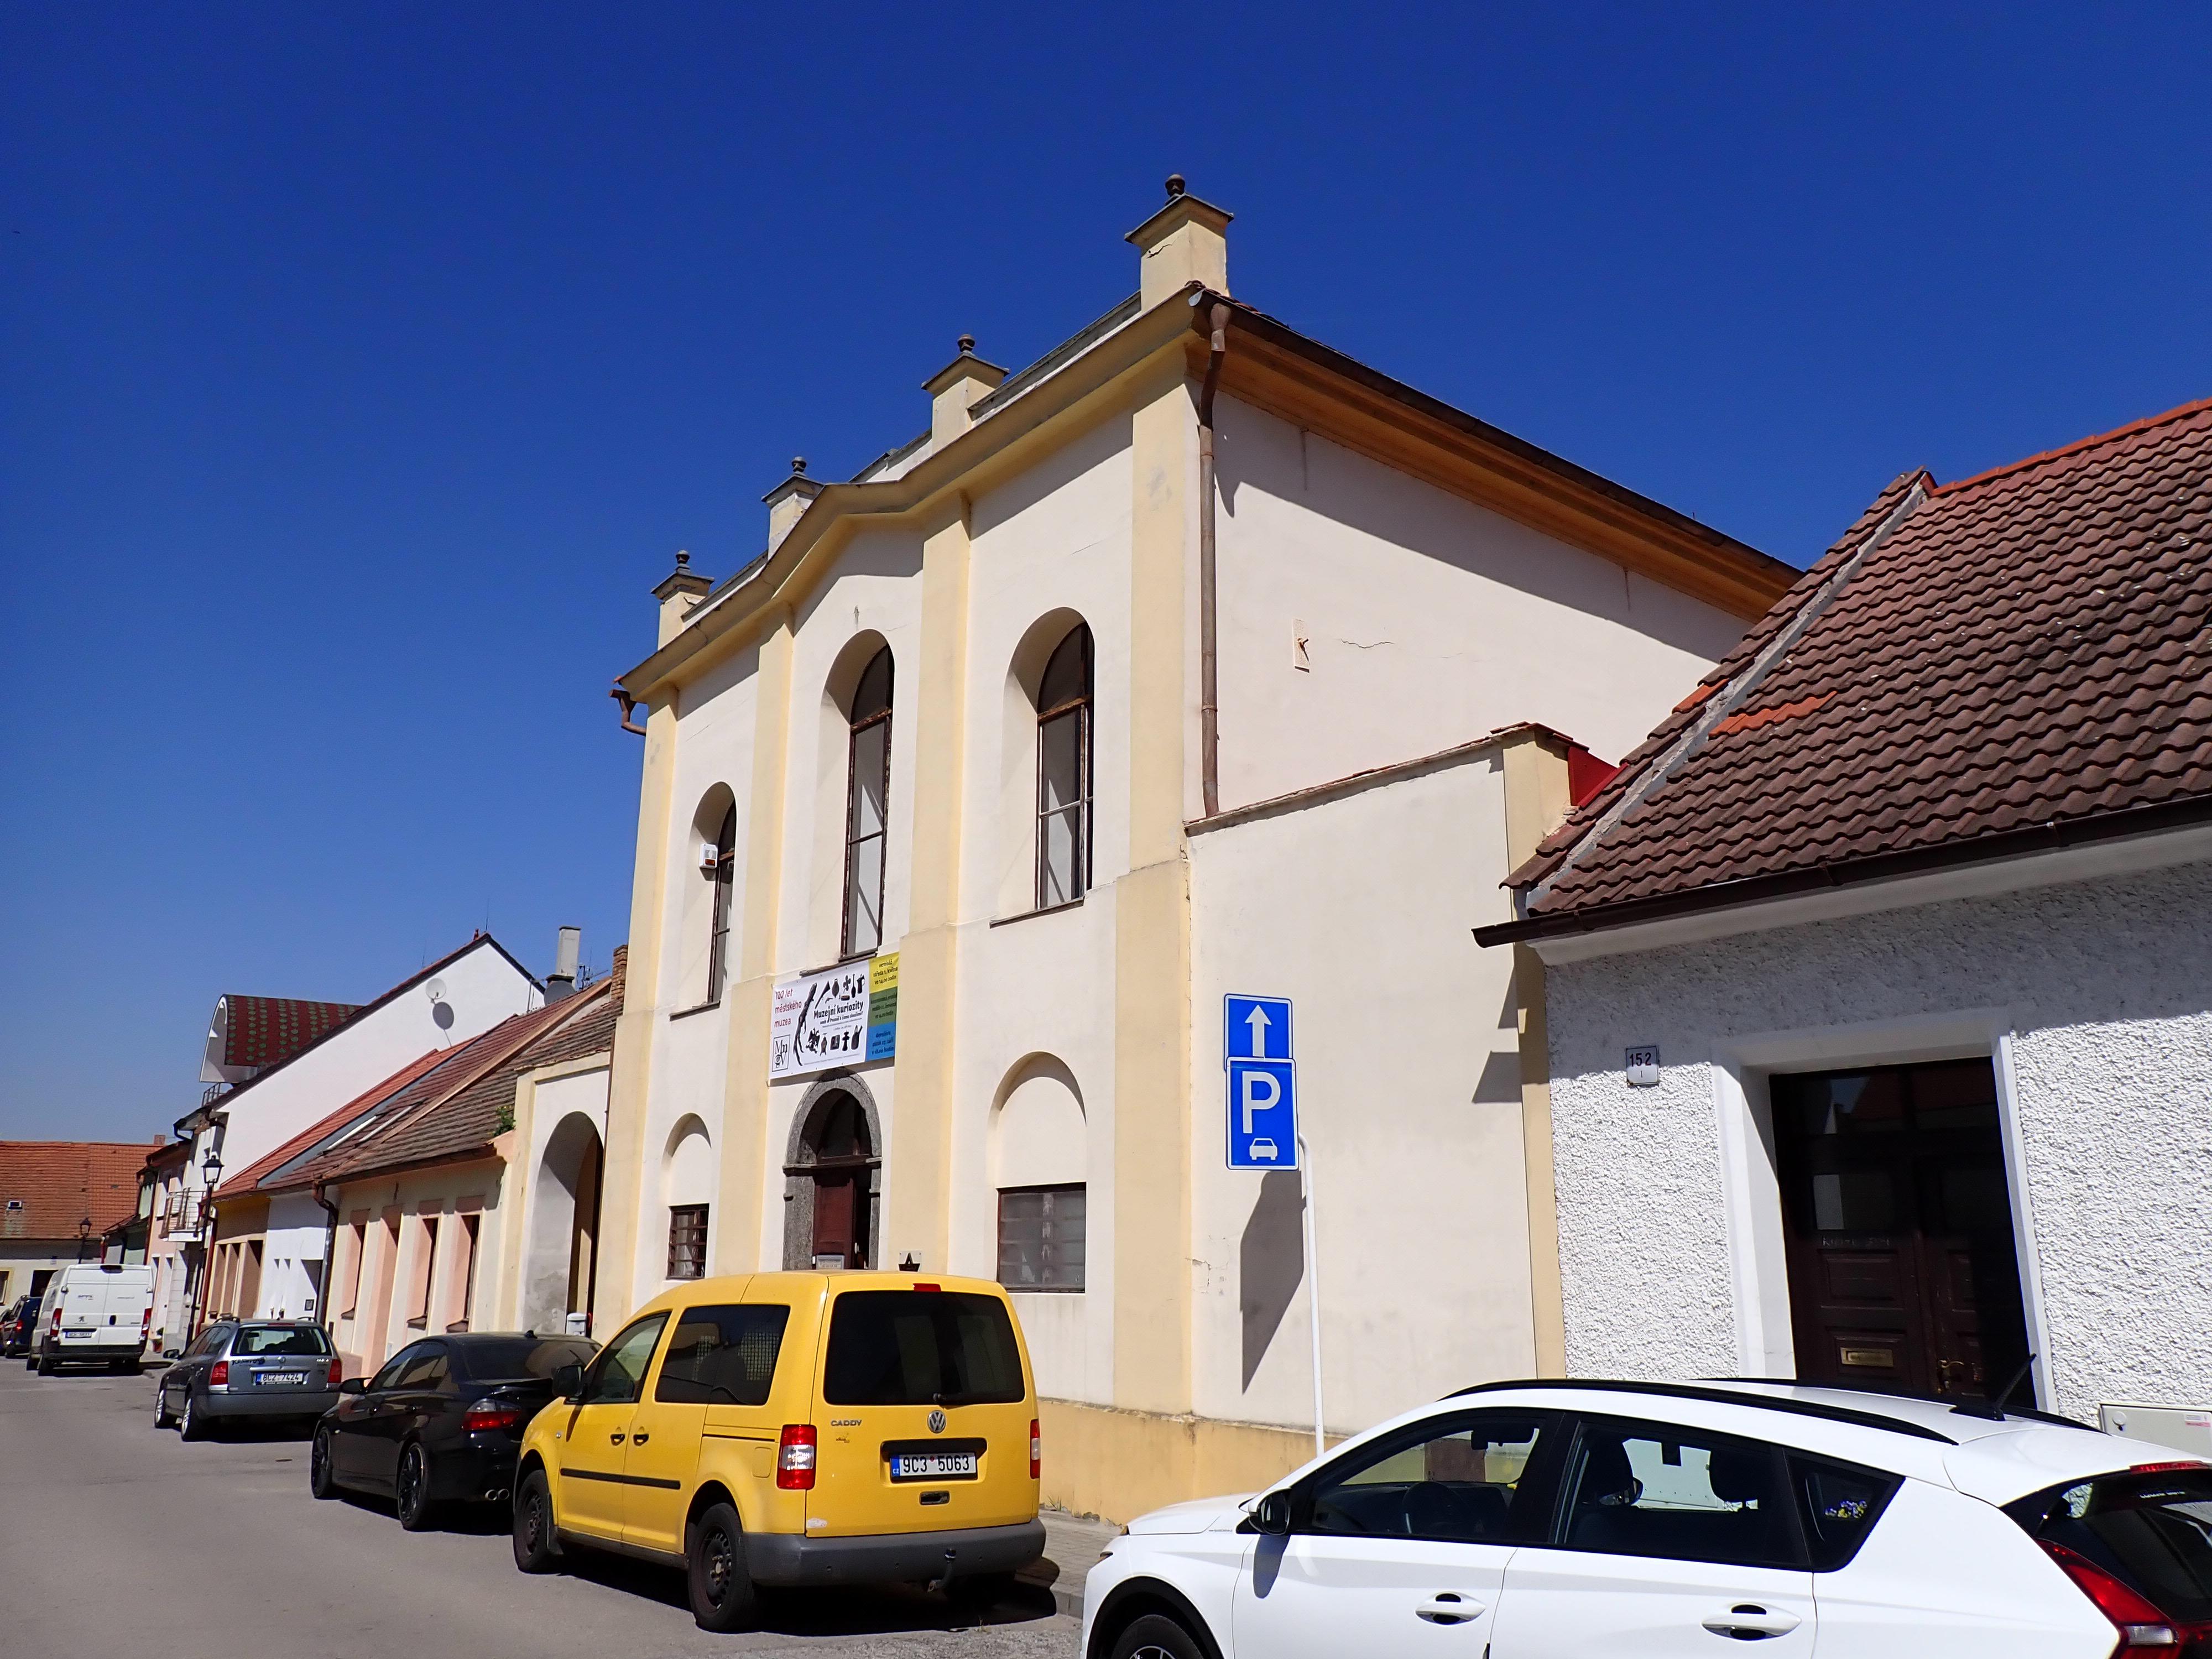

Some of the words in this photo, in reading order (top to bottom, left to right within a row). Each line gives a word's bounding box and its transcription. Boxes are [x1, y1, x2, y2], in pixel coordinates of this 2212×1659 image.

[775, 990, 784, 1000] 120
[775, 1000, 802, 1014] městského
[813, 1005, 836, 1022] Muzejní
[837, 1000, 863, 1014] kuriozity
[774, 1018, 791, 1027] muzea
[1630, 1052, 1651, 1067] 152
[1242, 1071, 1281, 1134] P
[903, 1456, 927, 1473] 9C3
[937, 1455, 969, 1471] 5063
